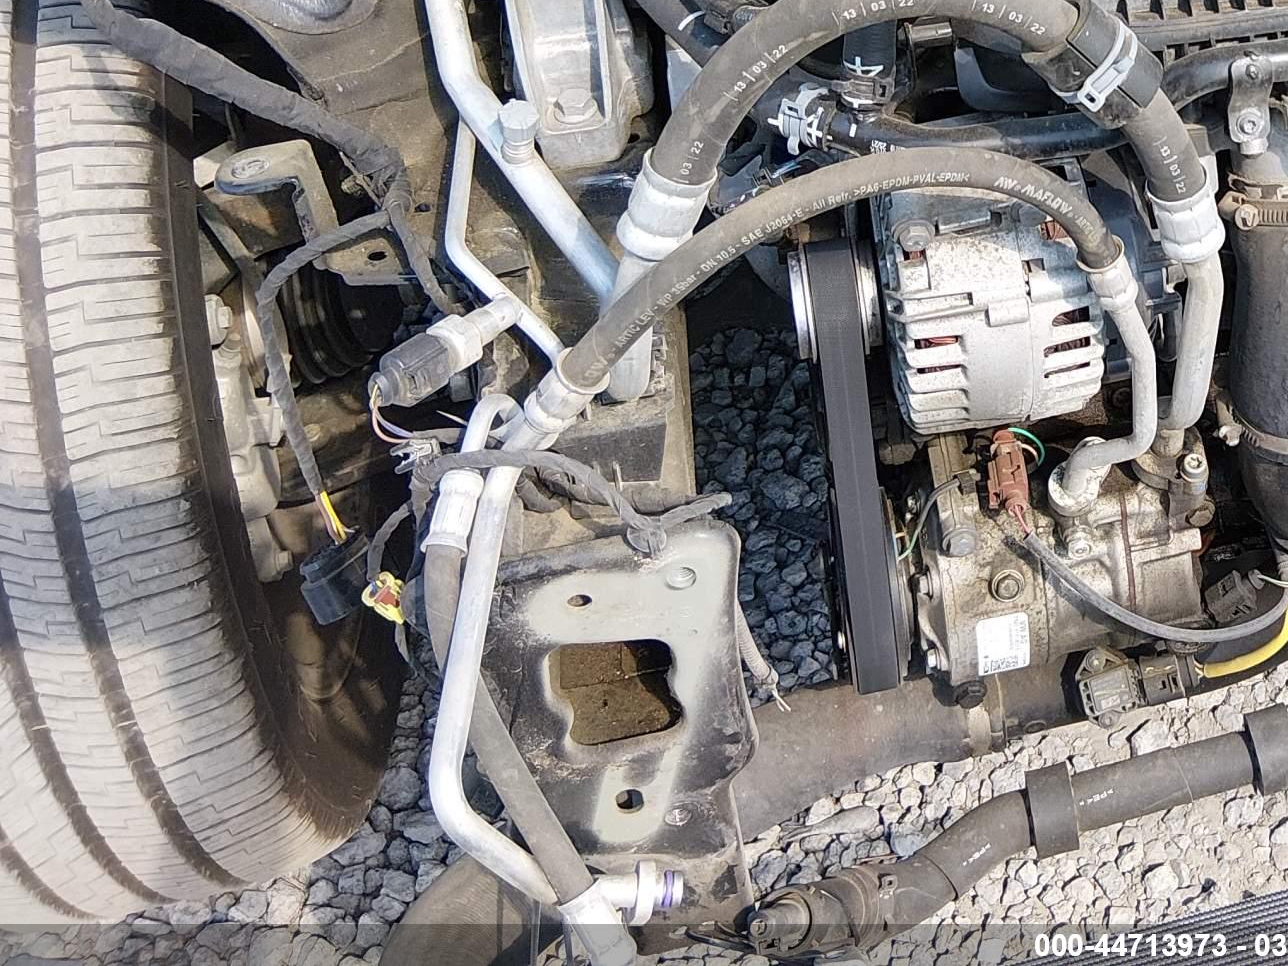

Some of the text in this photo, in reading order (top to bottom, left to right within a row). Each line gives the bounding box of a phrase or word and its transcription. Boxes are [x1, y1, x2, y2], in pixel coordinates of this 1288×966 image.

[842, 8, 857, 20] 13
[871, 0, 887, 11] 03
[981, 2, 1046, 35] 13 03 22
[734, 44, 788, 93] 13 03 22
[680, 140, 705, 175] 03 22
[1169, 163, 1181, 176] 03
[1175, 181, 1187, 195] 22
[700, 258, 718, 272] DN
[741, 228, 765, 245] SAE
[812, 198, 826, 210] All
[827, 191, 852, 207] Refr.
